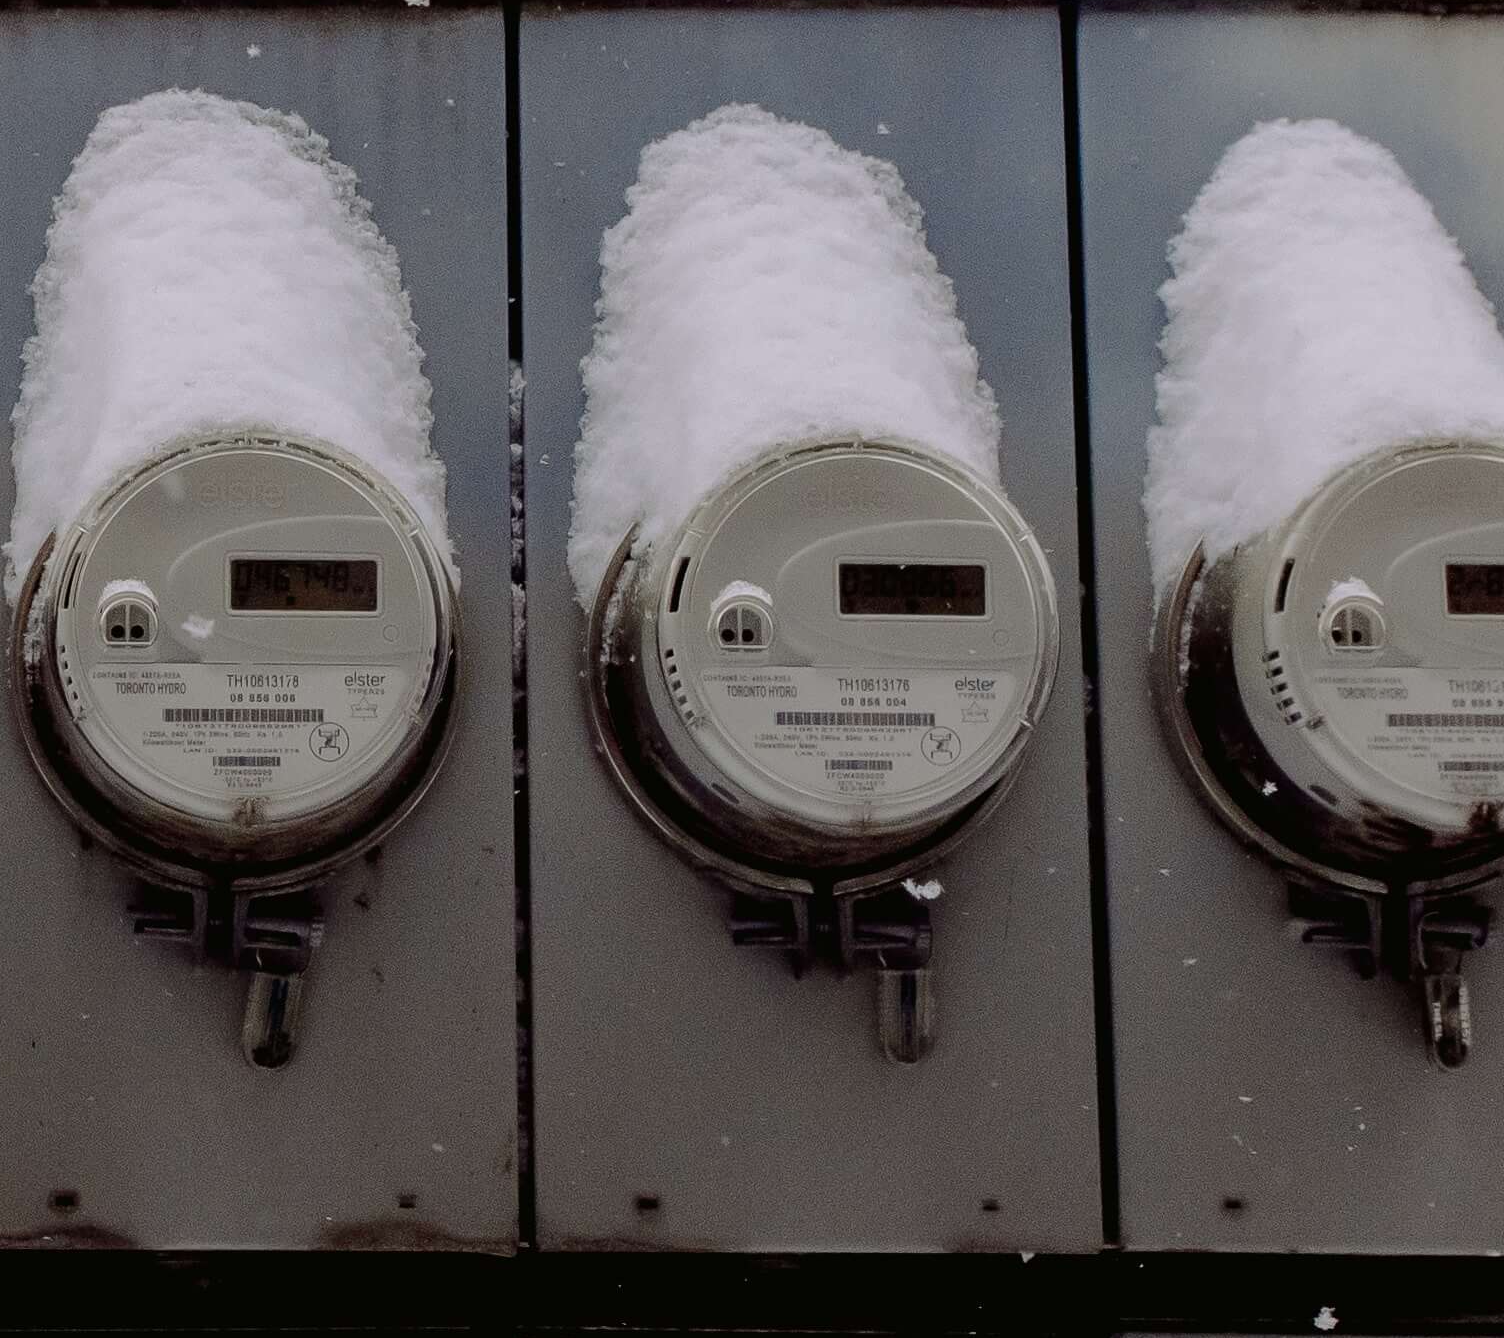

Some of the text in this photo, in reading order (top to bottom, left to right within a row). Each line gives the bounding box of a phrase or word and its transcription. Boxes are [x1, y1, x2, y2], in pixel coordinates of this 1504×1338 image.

[344, 670, 386, 688] elster
[954, 677, 996, 692] elster
[115, 682, 186, 695] TORONTO HYDRO
[727, 684, 798, 699] TORONTO HYDRO
[1336, 686, 1376, 699] TORONTO
[229, 693, 244, 703] 08
[885, 697, 907, 707] 004
